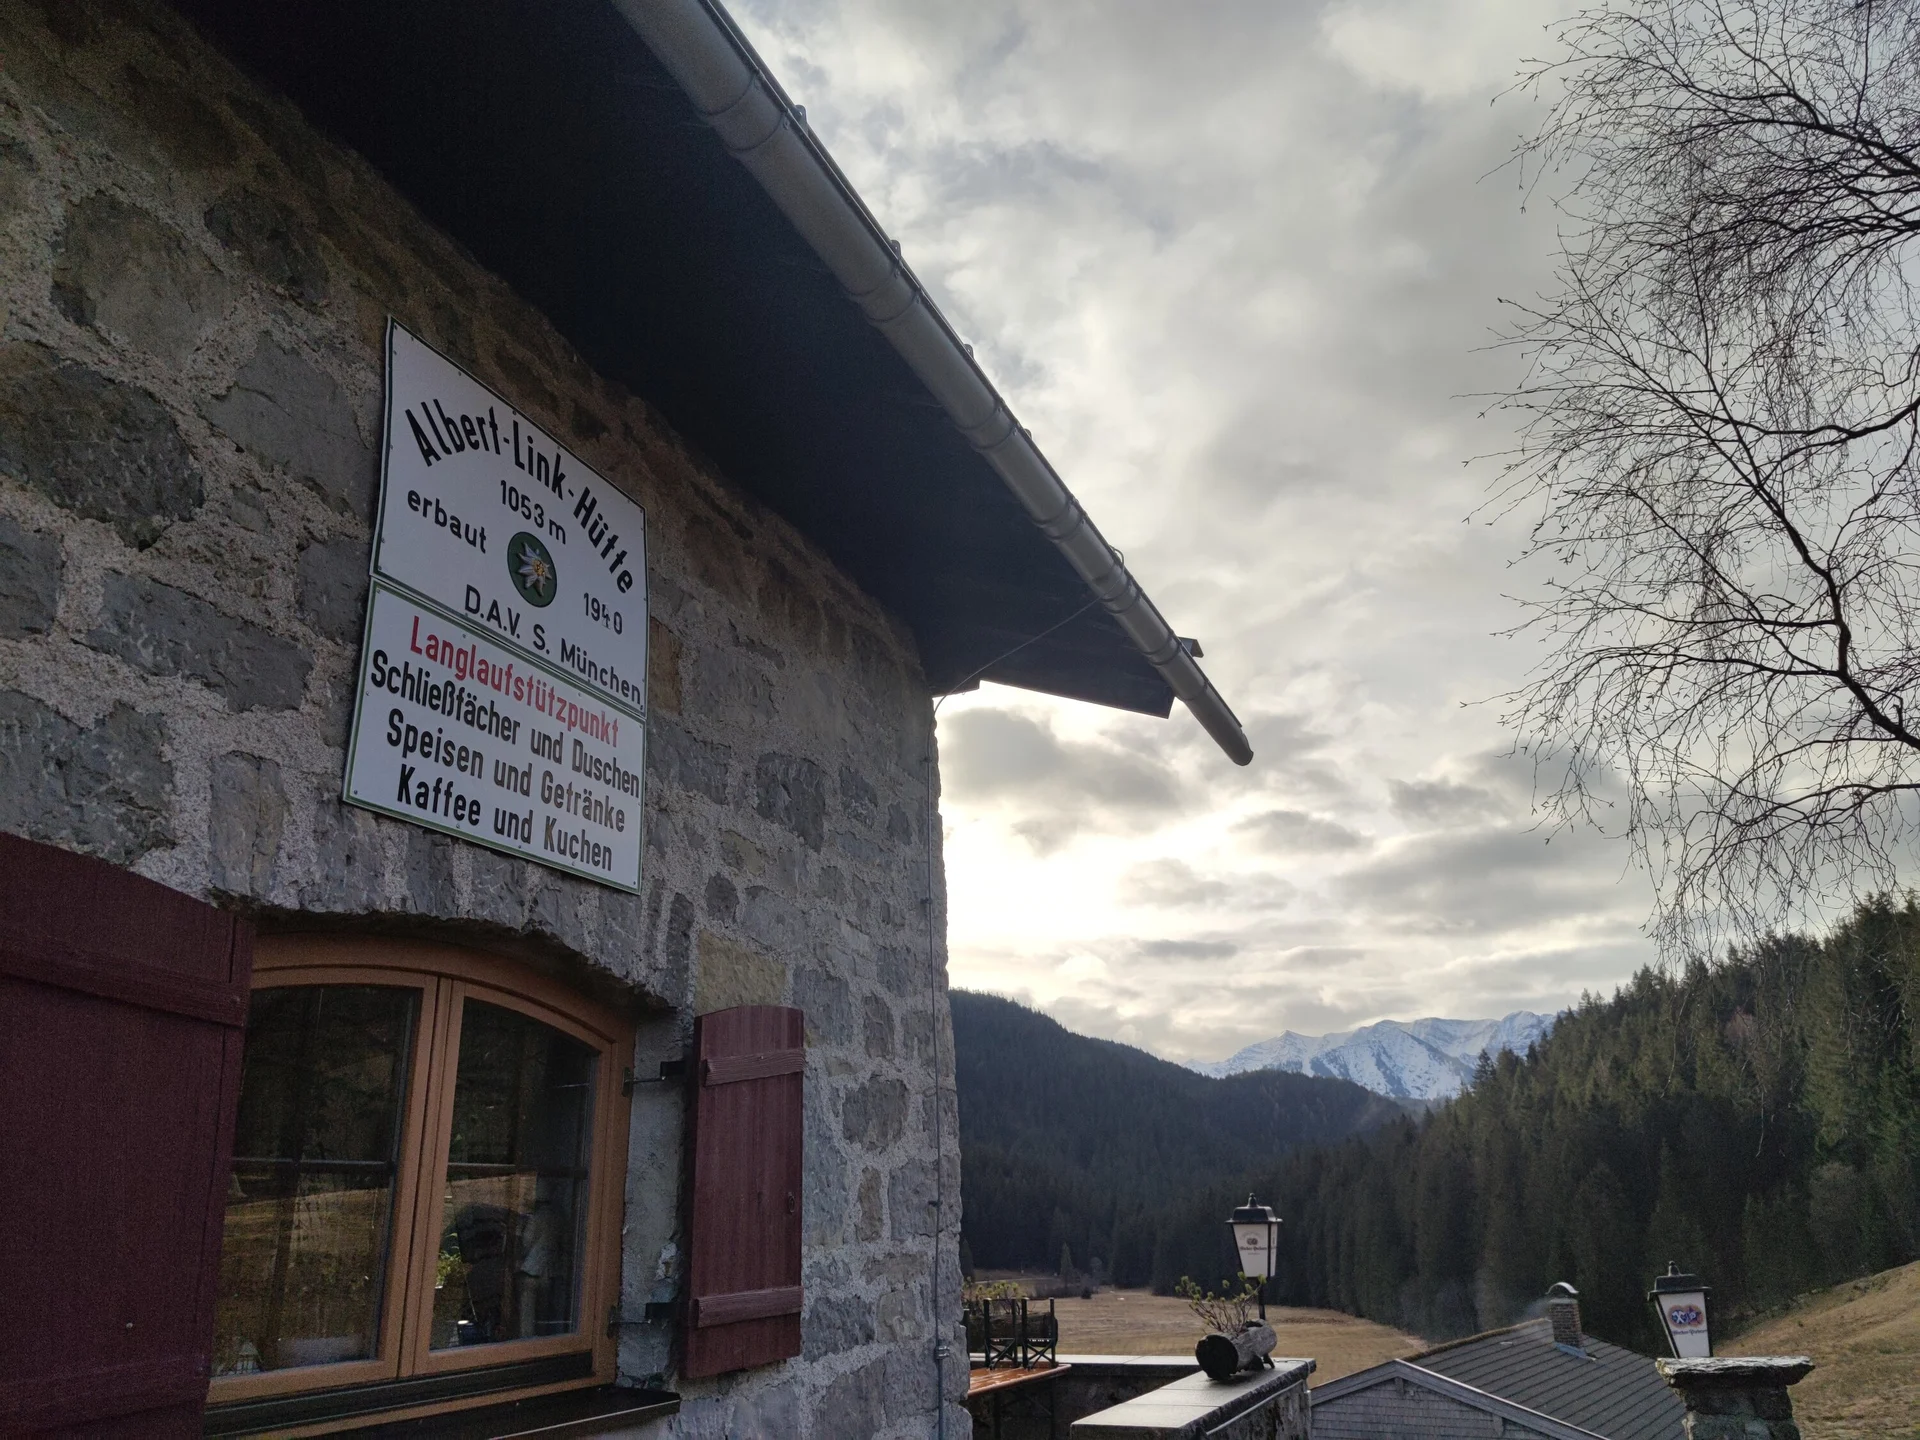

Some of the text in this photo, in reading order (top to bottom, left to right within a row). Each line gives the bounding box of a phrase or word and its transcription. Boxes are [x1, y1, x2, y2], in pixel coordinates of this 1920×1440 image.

[404, 399, 633, 594] Albert-Link-Hütte
[500, 479, 567, 545] 1053 m
[407, 489, 623, 635] erbaut 1940
[370, 649, 640, 798] Schließfächer und Duschen
[410, 615, 619, 748] Langlaufstützpunkt
[532, 623, 551, 655] S.
[560, 637, 641, 705] München
[386, 708, 625, 832] Speisen und Getränke
[397, 763, 613, 872] Kaffee und Kuchen
